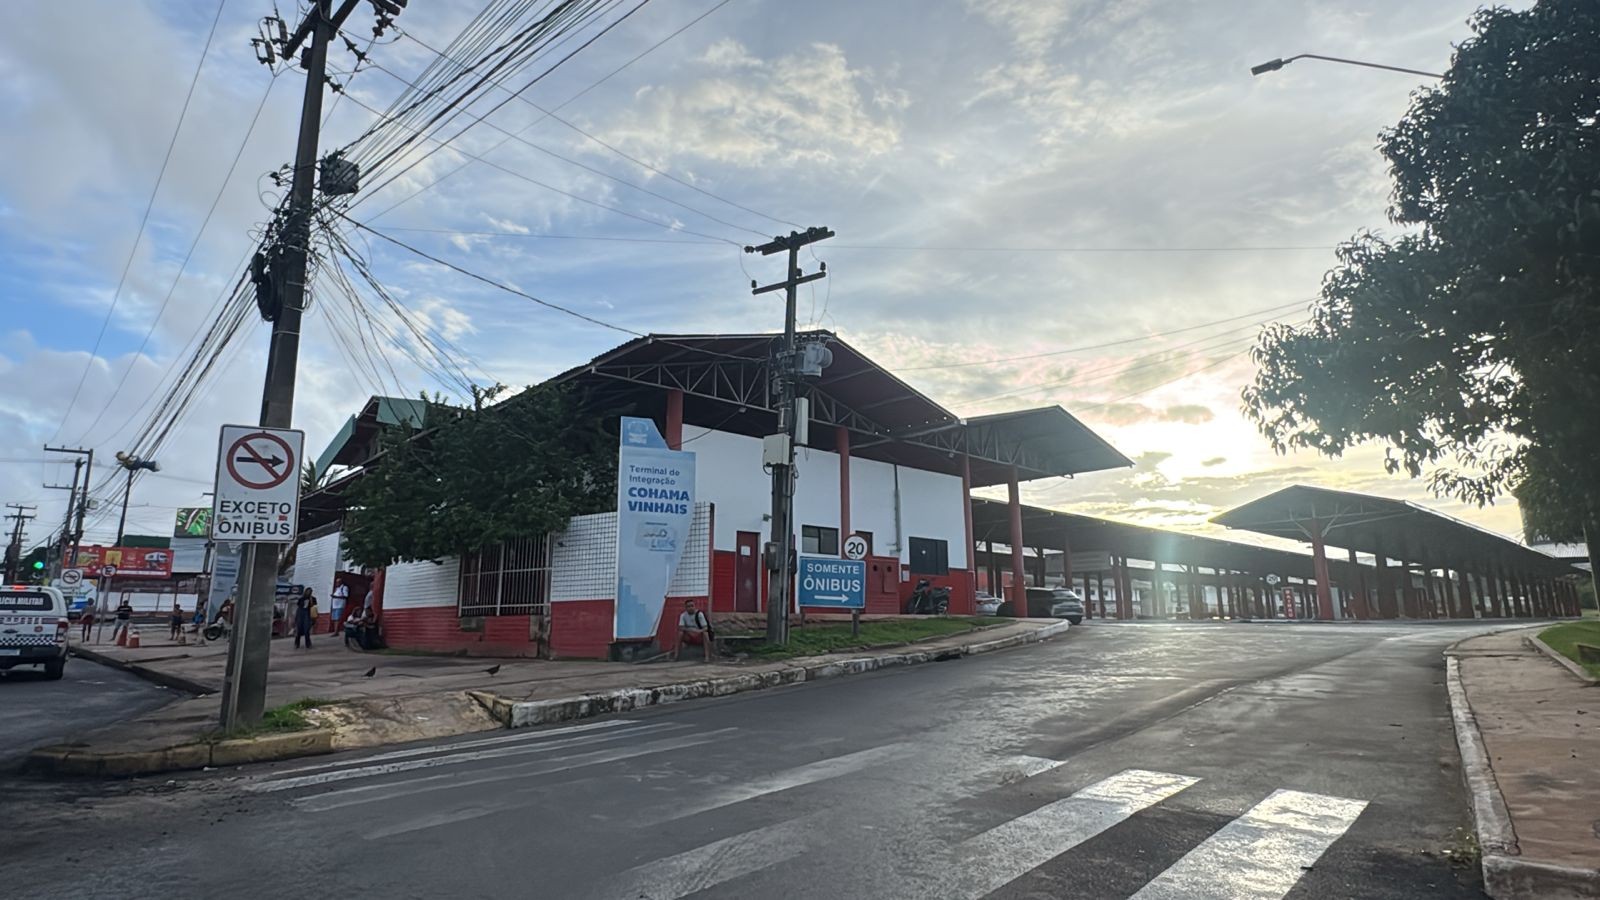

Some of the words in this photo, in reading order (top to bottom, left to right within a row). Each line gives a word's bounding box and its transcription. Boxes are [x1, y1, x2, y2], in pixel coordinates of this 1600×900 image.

[629, 465, 668, 476] Terminal
[669, 468, 681, 477] de
[629, 475, 676, 486] Integração
[628, 487, 690, 501] COHAMA
[220, 500, 292, 515] EXCETO
[628, 501, 688, 515] VINHAIS
[847, 541, 865, 556] 20
[807, 563, 860, 575] SOMENTE
[803, 574, 861, 593] ÔNIBUS
